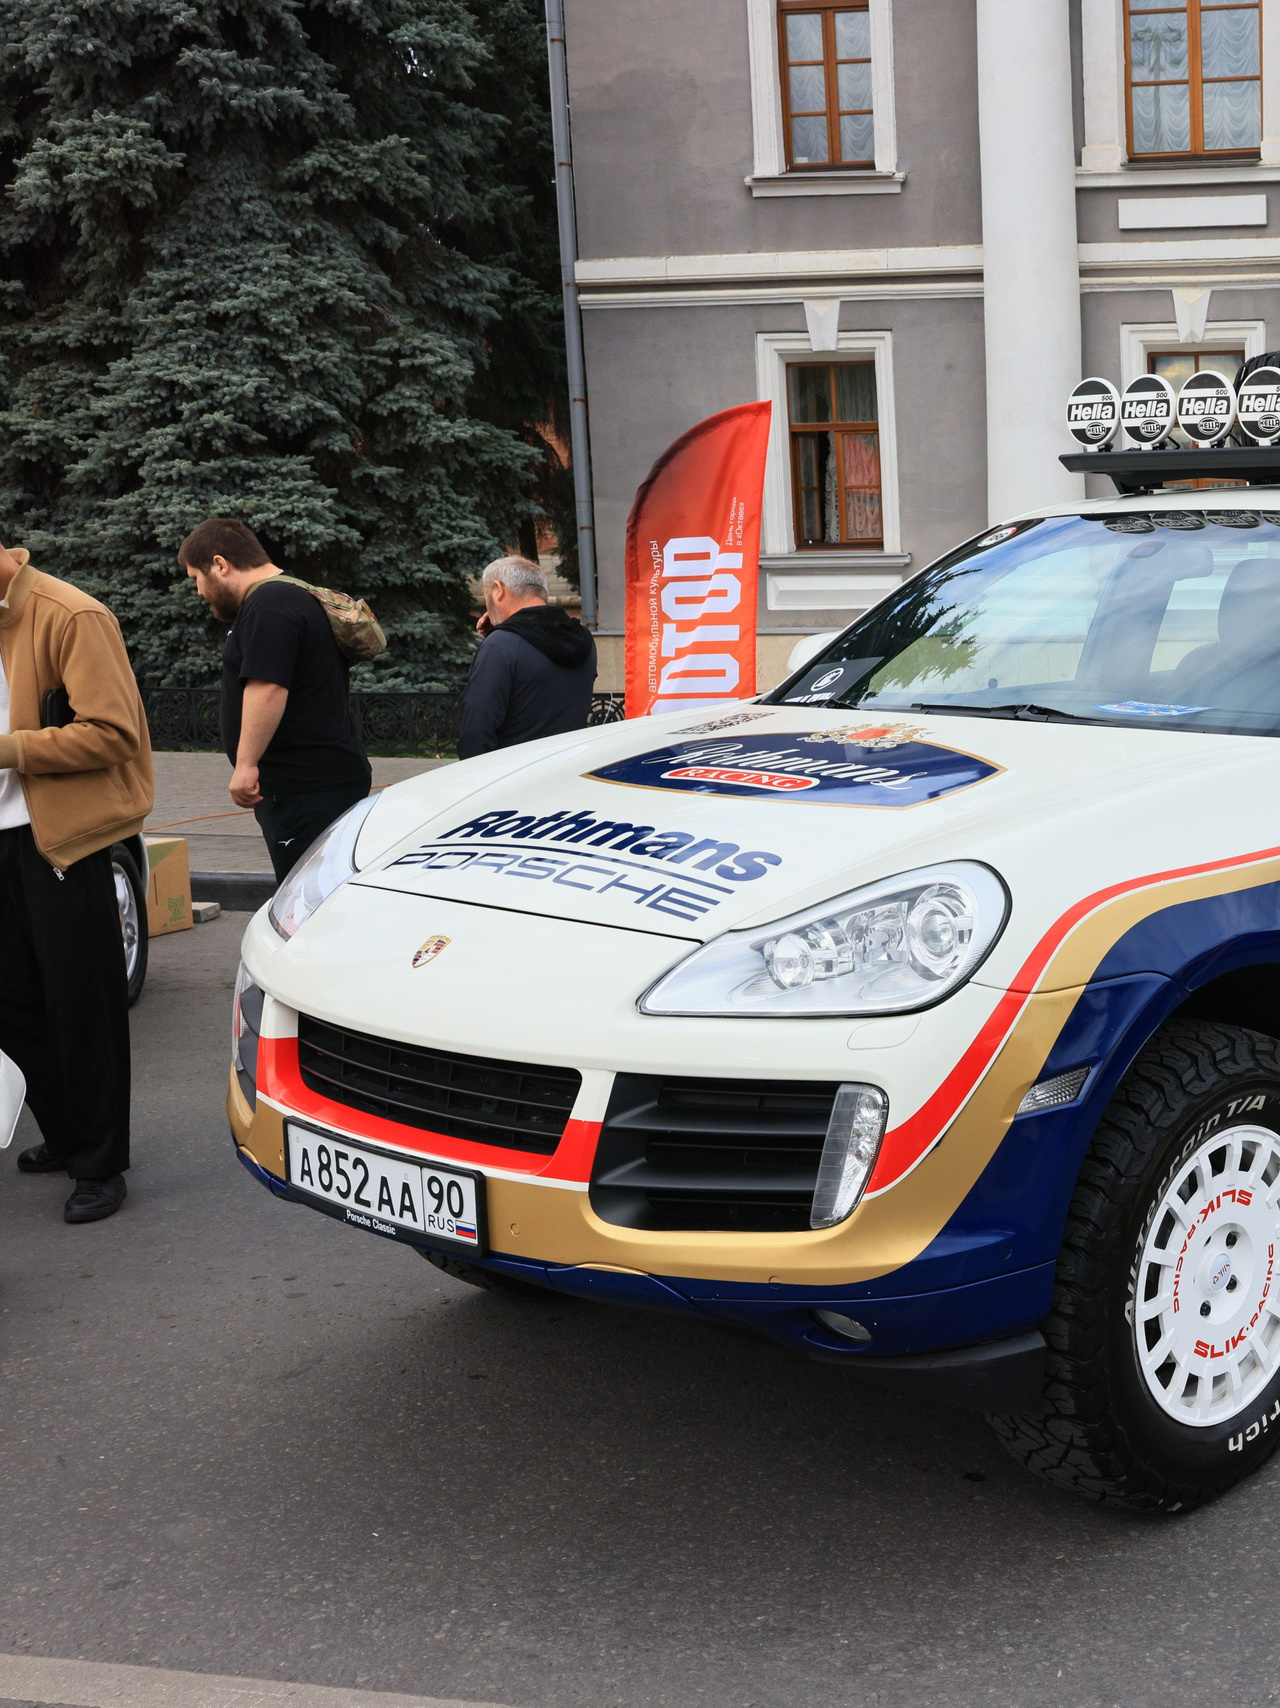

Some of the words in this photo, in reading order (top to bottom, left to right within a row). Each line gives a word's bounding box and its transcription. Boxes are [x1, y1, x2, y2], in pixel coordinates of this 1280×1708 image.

[1070, 403, 1113, 421] Hella
[1124, 400, 1168, 418] Hella
[1181, 397, 1228, 415] Hella
[1087, 426, 1106, 435] HELLA
[1141, 423, 1162, 433] HELLA
[1199, 420, 1220, 430] HELLA
[1259, 418, 1280, 428] HELLA
[729, 496, 737, 524] города
[725, 525, 734, 546] День
[648, 540, 662, 594] культуры
[648, 597, 660, 693] автомобильной
[641, 743, 928, 790] Rothmans
[678, 768, 803, 789] RACING
[438, 810, 783, 881] Rothmans
[383, 852, 721, 922] PORSCHE
[1226, 1095, 1266, 1119] T/A
[426, 1175, 464, 1219] 90
[1199, 1189, 1253, 1225] SLIK
[346, 1209, 371, 1228] Porsche
[371, 1218, 396, 1236] Classic
[428, 1214, 455, 1233] RUS
[1172, 1224, 1197, 1314] RACING
[1193, 1326, 1247, 1359] SLIK
[1249, 1243, 1274, 1328] RACING
